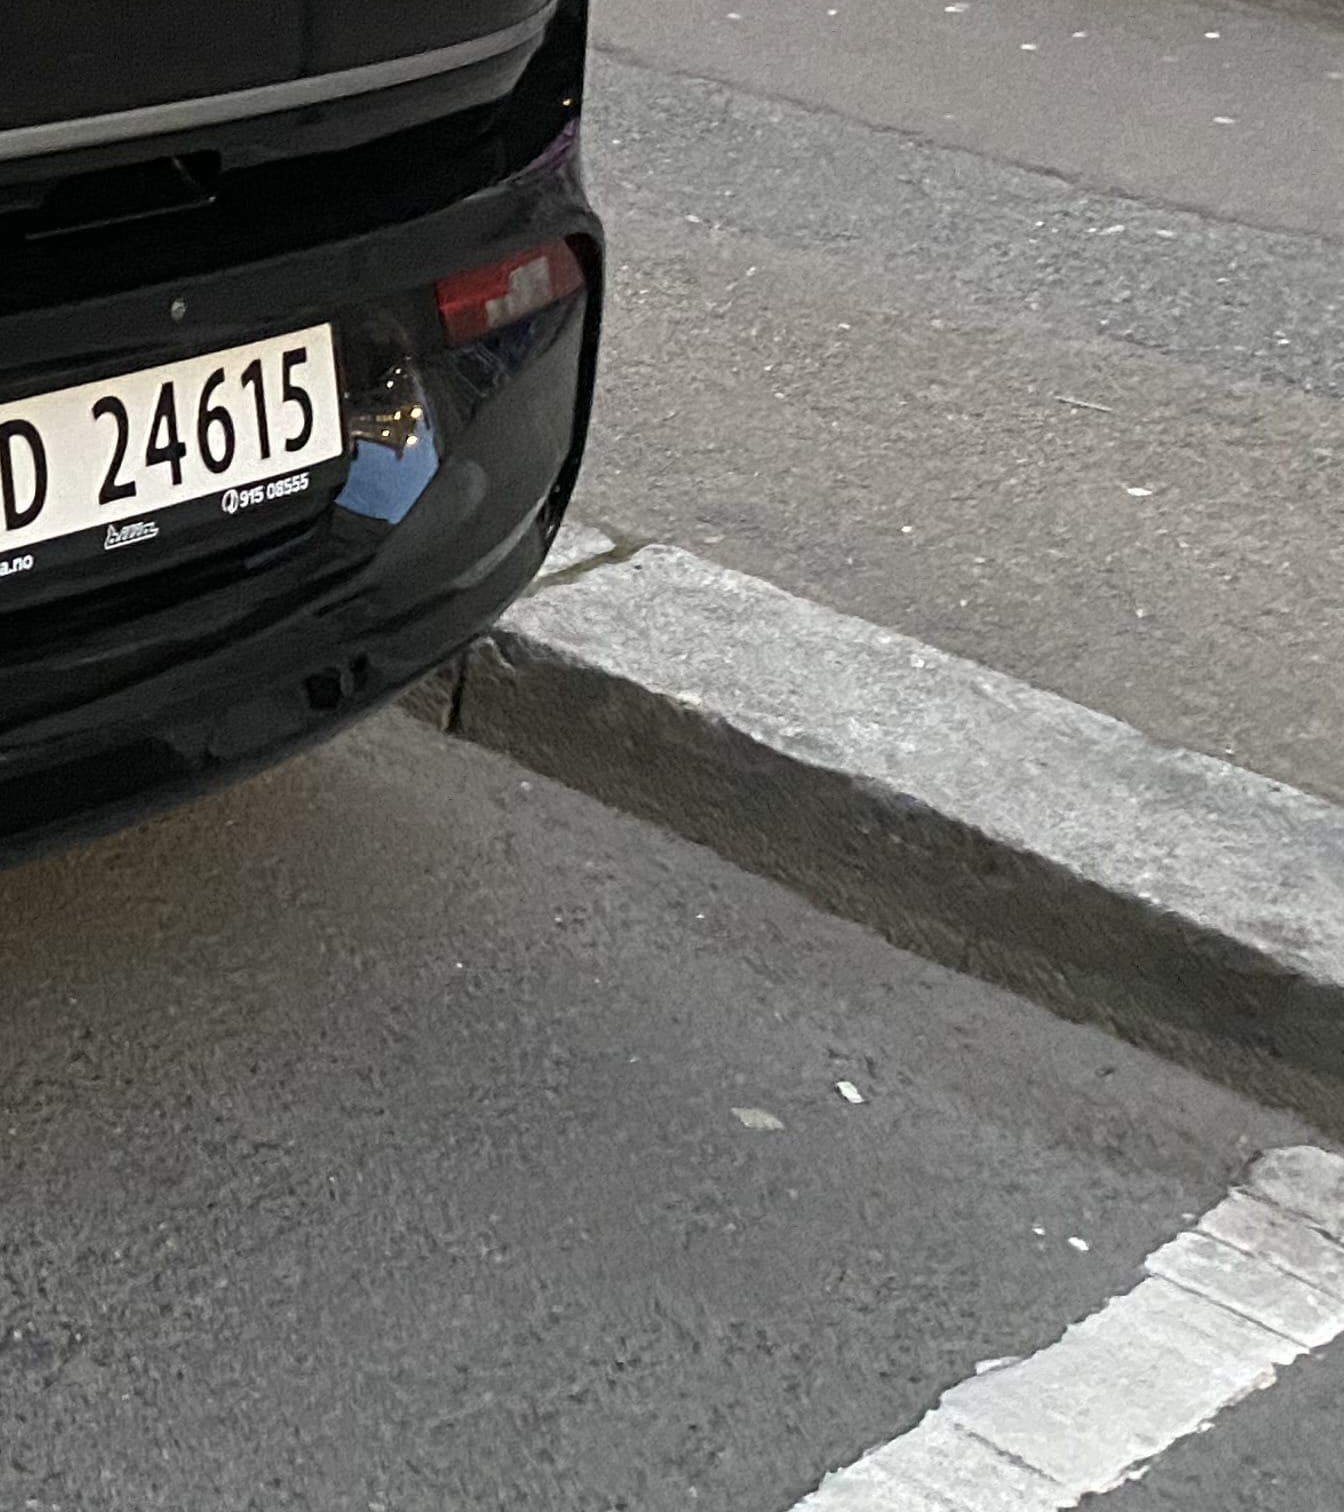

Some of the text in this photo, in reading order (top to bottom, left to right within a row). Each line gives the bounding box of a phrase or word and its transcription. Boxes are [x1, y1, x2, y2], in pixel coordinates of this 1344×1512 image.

[91, 346, 313, 505] 24615
[239, 471, 310, 508] 915 08555
